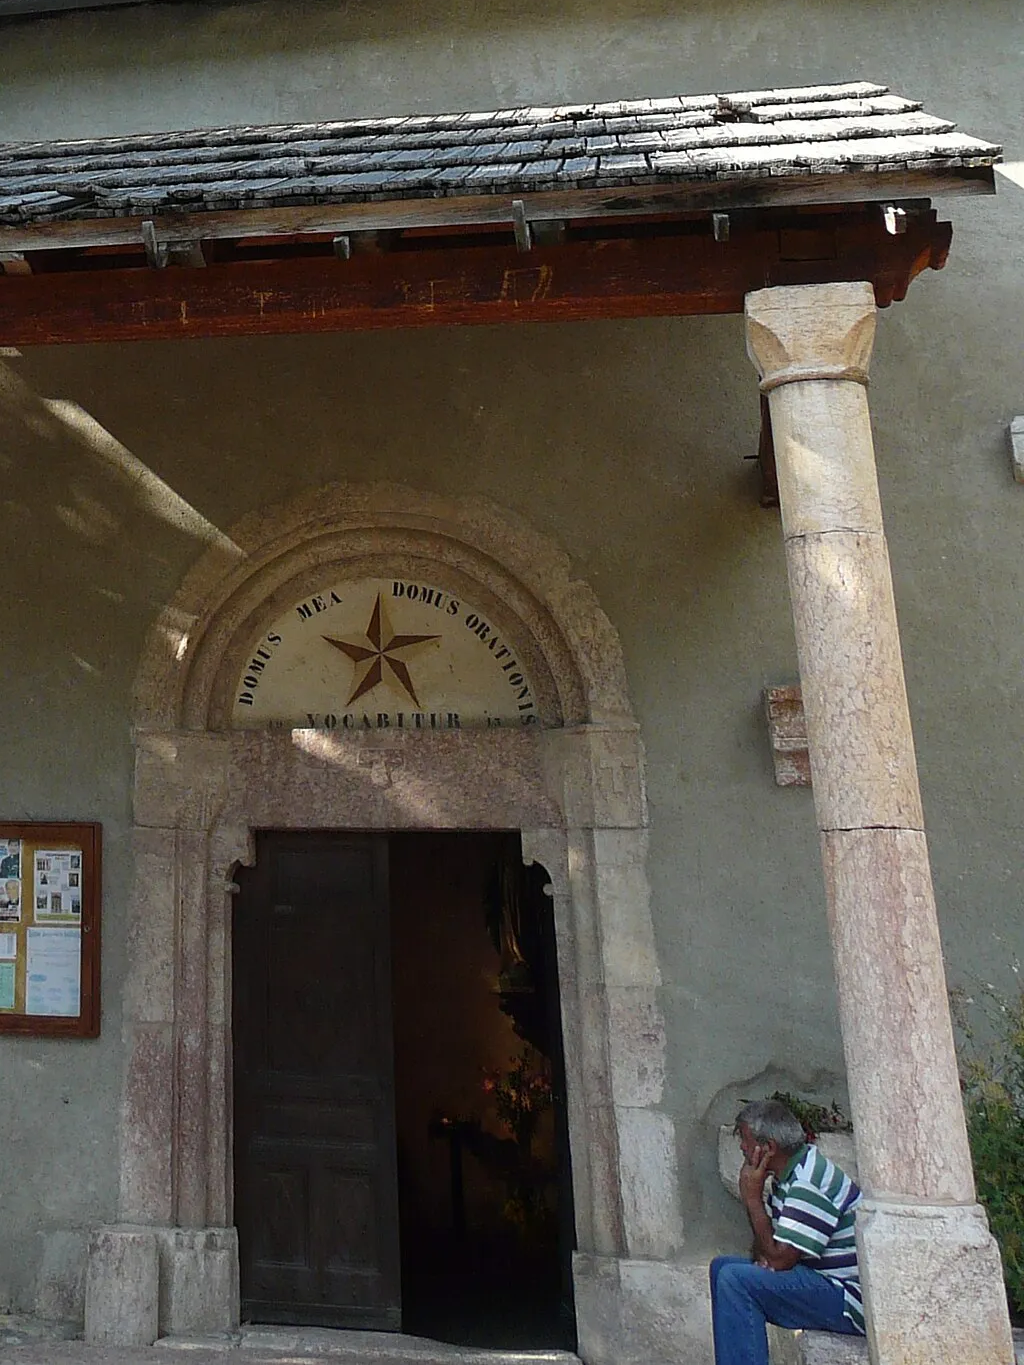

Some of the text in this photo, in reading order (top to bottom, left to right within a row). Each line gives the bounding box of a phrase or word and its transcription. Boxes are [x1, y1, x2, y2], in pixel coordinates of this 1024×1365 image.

[239, 581, 537, 726] DOMUS MEA DOMUS ORATIONIS
[306, 713, 461, 729] VOCABITUR
